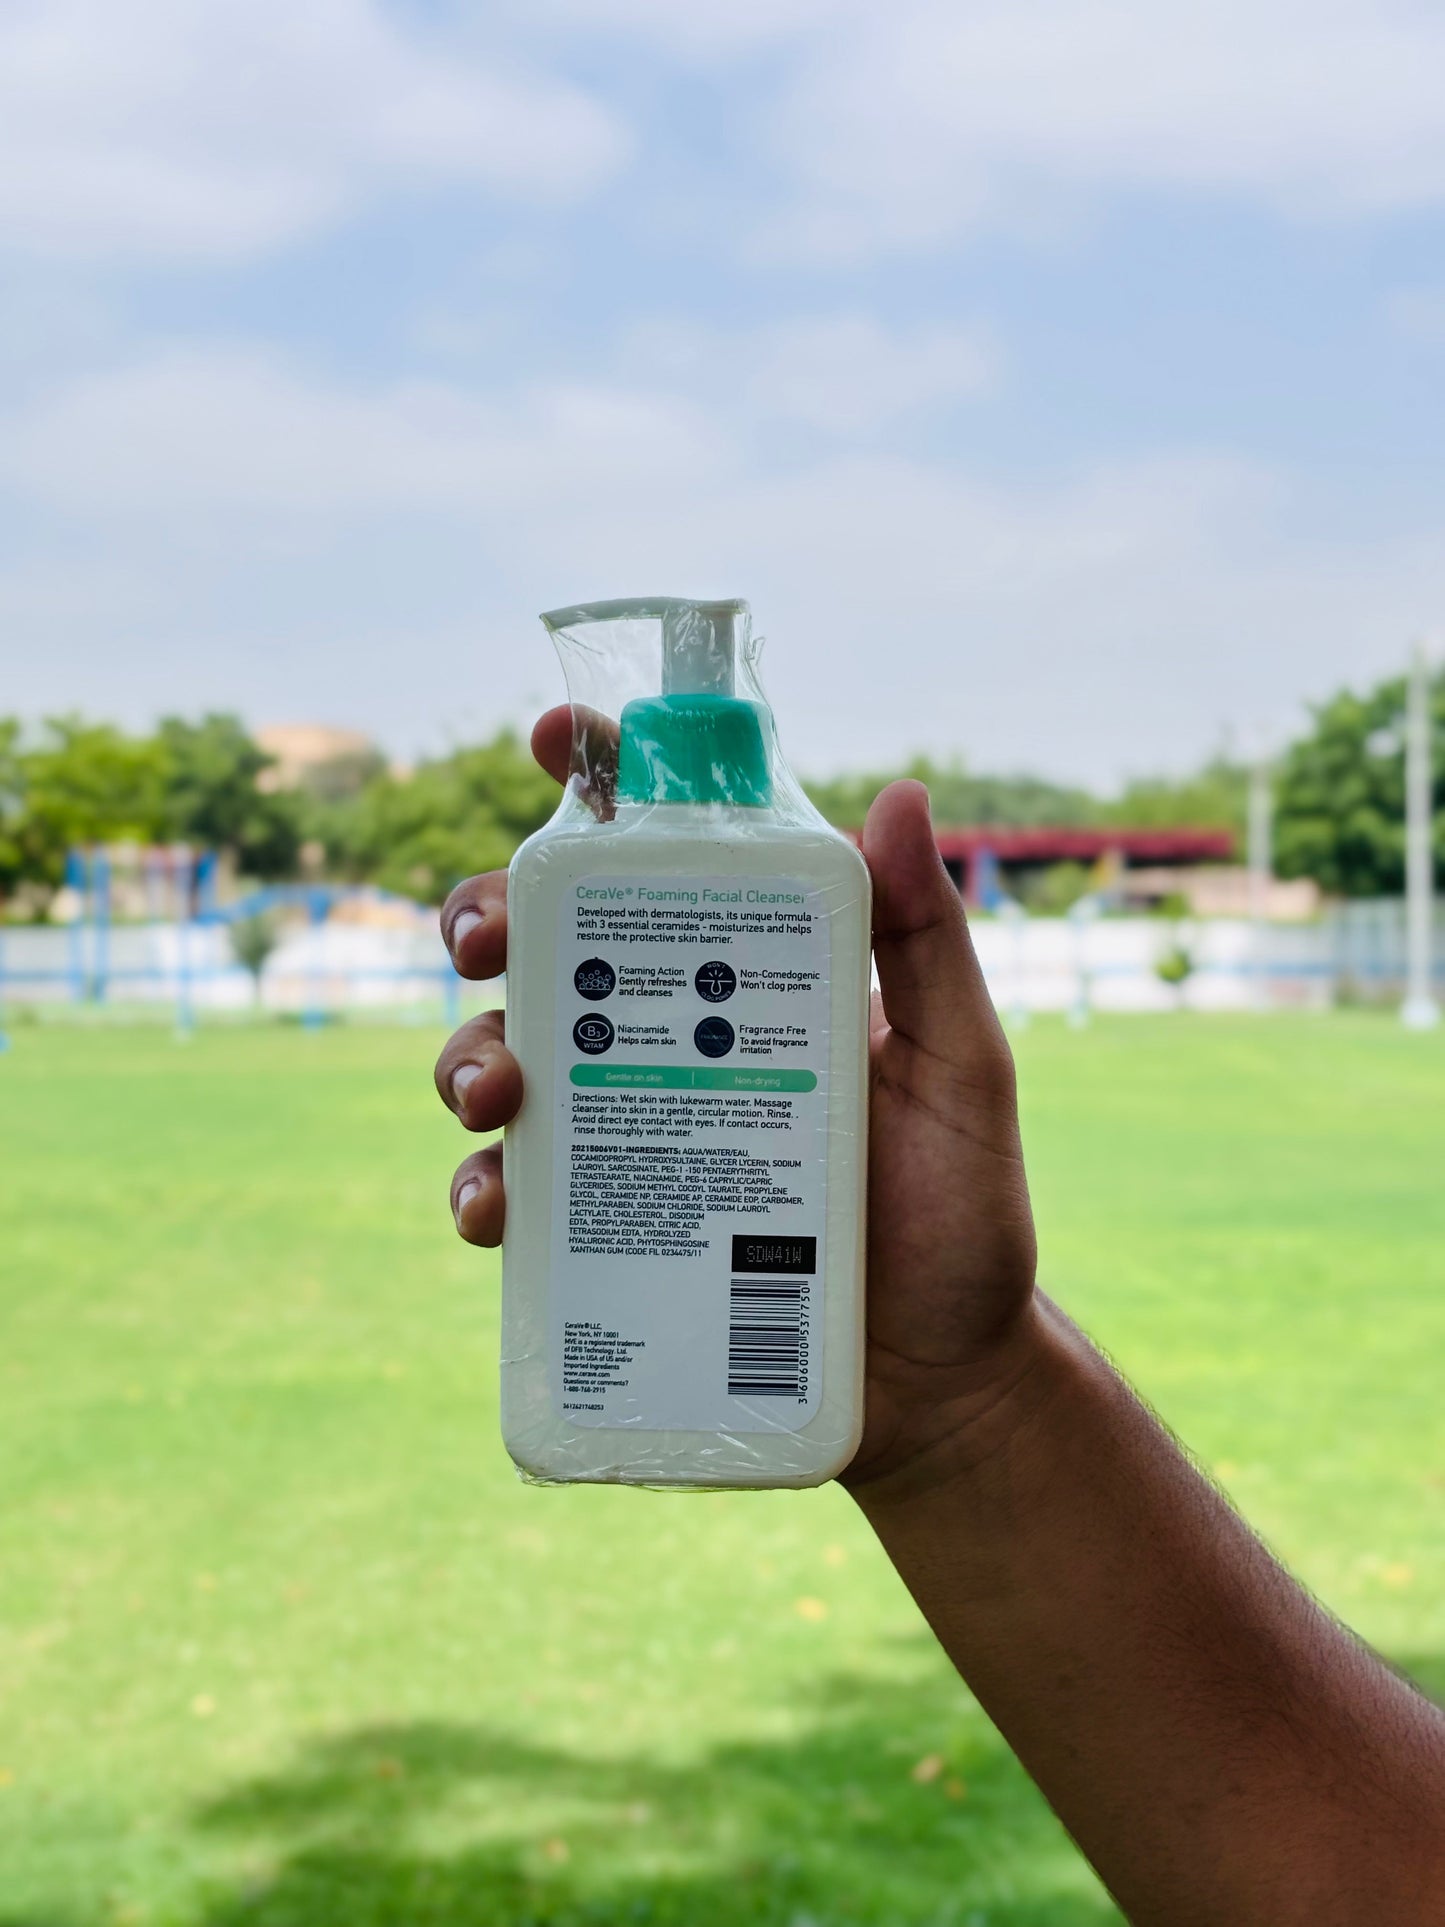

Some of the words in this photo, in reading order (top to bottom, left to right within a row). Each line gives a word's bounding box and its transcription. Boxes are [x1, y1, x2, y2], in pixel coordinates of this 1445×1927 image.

[577, 886, 633, 900] CeraVe®
[638, 888, 698, 904] Foaming
[703, 889, 742, 902] Facial
[578, 907, 626, 919] Developed
[628, 908, 648, 918] with
[651, 908, 724, 921] dermatologists,
[727, 910, 738, 920] its
[741, 911, 772, 922] unique
[775, 911, 811, 921] formula
[577, 919, 597, 928] with
[600, 920, 605, 928] 3
[608, 920, 649, 930] essential
[652, 922, 700, 931] ceramides
[710, 922, 764, 932] moisturizes
[767, 924, 784, 933] and
[787, 924, 812, 936] helps
[577, 932, 610, 940] restore
[613, 932, 627, 941] the
[630, 934, 676, 943] protective
[678, 934, 697, 942] skin
[700, 934, 733, 944] barrier.
[619, 966, 655, 976] Foaming
[658, 967, 684, 976] Action
[740, 970, 820, 981] Non-Comedogenic
[619, 977, 646, 986] Gently
[648, 978, 687, 986] refreshes
[740, 981, 765, 989] Won't
[767, 981, 785, 991] clog
[788, 983, 811, 992] pores
[636, 988, 672, 996] cleanses
[618, 1025, 669, 1034] Niacinamide
[740, 1025, 784, 1035] Fragrance
[787, 1026, 806, 1034] Free
[618, 1036, 639, 1045] Helps
[641, 1037, 659, 1045] calm
[773, 1038, 808, 1047] fragrance
[735, 1076, 780, 1087] Non-drying
[573, 1093, 617, 1102] Directions:
[620, 1094, 636, 1103] Wet
[639, 1095, 656, 1103] skin
[659, 1096, 677, 1104] with
[680, 1096, 722, 1105] lukewarm
[754, 1099, 792, 1109] Massage
[572, 1104, 608, 1112] cleanser
[611, 1105, 626, 1113] into
[629, 1106, 647, 1114] skin
[650, 1106, 657, 1114] in
[667, 1107, 695, 1116] gentle,
[572, 1115, 596, 1123] Avoid
[598, 1115, 621, 1124] direct
[624, 1118, 638, 1126] eye
[641, 1117, 672, 1125] contact
[674, 1117, 692, 1126] with
[695, 1120, 716, 1128] eyes.
[727, 1120, 758, 1128] contact
[761, 1122, 791, 1130] occurs,
[598, 1126, 644, 1137] thoroughly
[646, 1127, 664, 1135] with
[571, 1154, 636, 1162] COCAMIDOPROPYL
[608, 1164, 659, 1173] SARCOSINATE,
[703, 1167, 769, 1176] PENTAERYTHRITYL
[571, 1172, 631, 1181] TETRASTEARATE,
[634, 1174, 683, 1183] NIACINAMIDE,
[709, 1176, 772, 1185] CAPRYLIC/CAPRIC
[570, 1182, 615, 1190] GLYCERIDES,
[653, 1193, 690, 1201] CERAMIDE
[705, 1194, 742, 1202] CERAMIDE
[761, 1197, 804, 1205] CARBOMER,
[570, 1201, 635, 1209] METHYLPARABEN,
[668, 1203, 704, 1211] CHLORIDE,
[570, 1209, 611, 1218] LACTYLATE,
[614, 1210, 667, 1219] CHOLESTEROL,
[569, 1227, 620, 1236] TETRASODIUM
[644, 1230, 690, 1238] HYDROLYZED
[569, 1237, 615, 1245] HYALURONIC
[637, 1239, 710, 1248] PHYTOSPHINGOSINE
